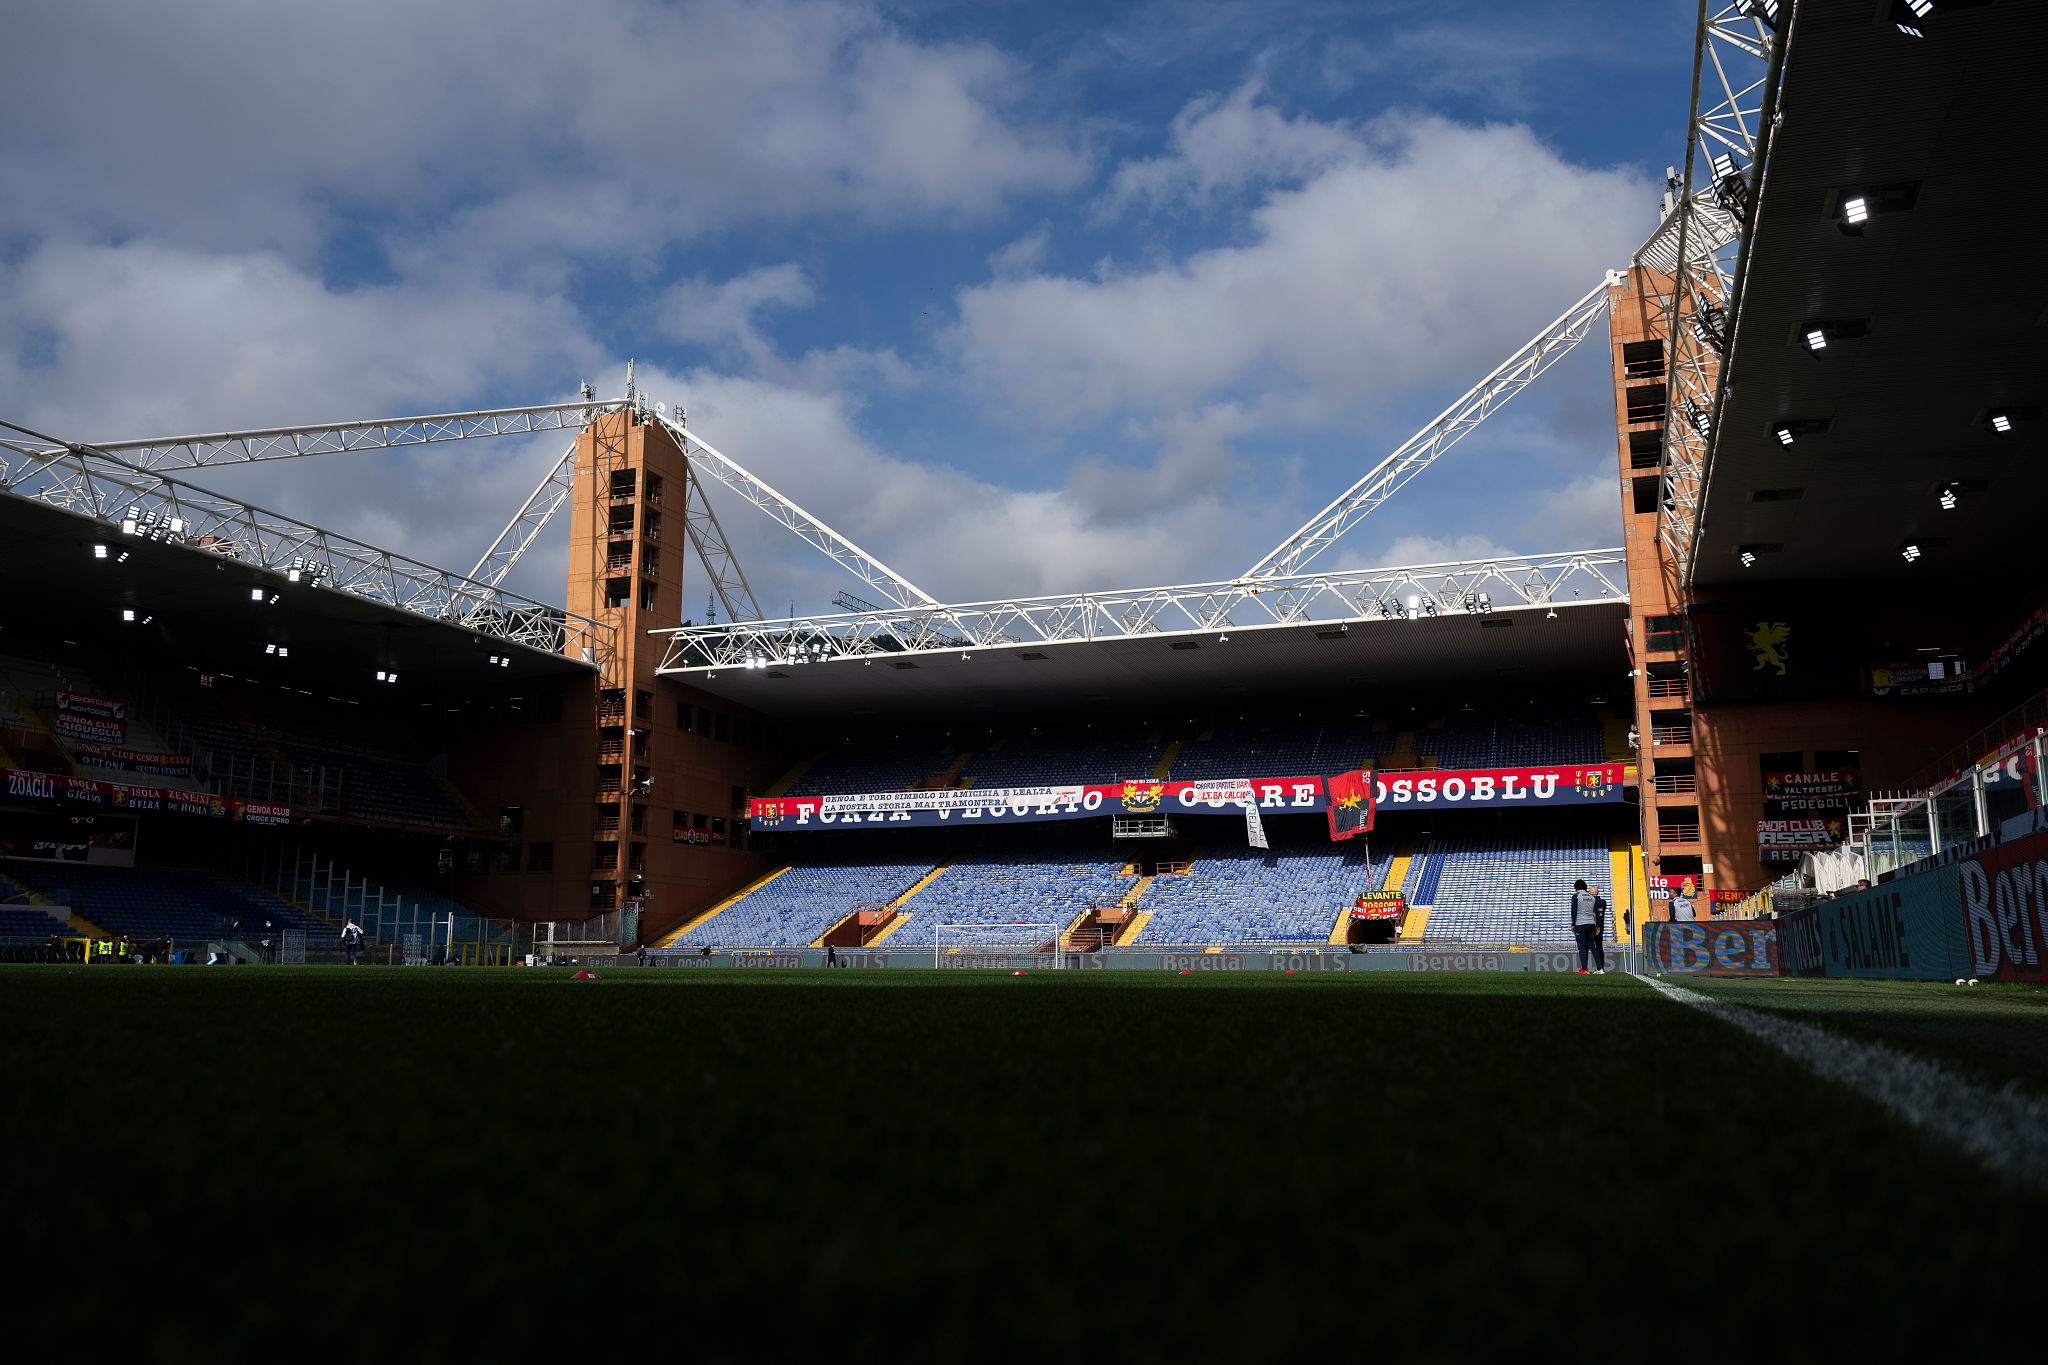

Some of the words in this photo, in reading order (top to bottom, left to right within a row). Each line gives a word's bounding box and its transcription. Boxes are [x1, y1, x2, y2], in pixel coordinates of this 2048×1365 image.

[59, 714, 93, 726] GENOA
[95, 720, 119, 730] CLUB
[56, 721, 122, 738] LAIGUEGLIA
[76, 743, 101, 755] GENOA
[112, 750, 135, 759] CLUB
[82, 756, 126, 770] OTTONE
[136, 754, 159, 762] GENOA
[1362, 771, 1371, 784] 52
[1784, 772, 1839, 784] CANALE
[8, 774, 54, 798] ZOAGLI
[68, 778, 98, 791] ISOLA
[1784, 785, 1843, 794] VALTREBBIA
[131, 787, 161, 798] ISOLA
[167, 789, 210, 804] ZENEIXI
[825, 795, 855, 803] GENOA
[938, 791, 951, 799] DI
[951, 789, 999, 798] AMICIZIA
[1002, 788, 1010, 796] E
[1178, 783, 1315, 808] CRE
[246, 804, 270, 815] GENOA
[272, 806, 290, 817] CLUB
[824, 804, 836, 812] LA
[839, 803, 875, 811] NOSTRA
[877, 801, 912, 810] STORIA
[914, 801, 936, 809] MAI
[1781, 798, 1849, 811] PEDEGOLI
[246, 814, 269, 823] CROCE
[270, 816, 290, 824] D'ORO
[1790, 819, 1826, 832] CLUB
[1362, 891, 1402, 900] LEVANTE
[1840, 892, 1910, 970] SALAME
[642, 959, 665, 967] EPCO
[678, 958, 711, 968] 00:00
[735, 955, 799, 968] Beretta
[826, 955, 885, 968] OLLS
[1163, 954, 1240, 970] Beretta
[1273, 954, 1346, 970] ROLLS
[1412, 953, 1501, 971] Beretta
